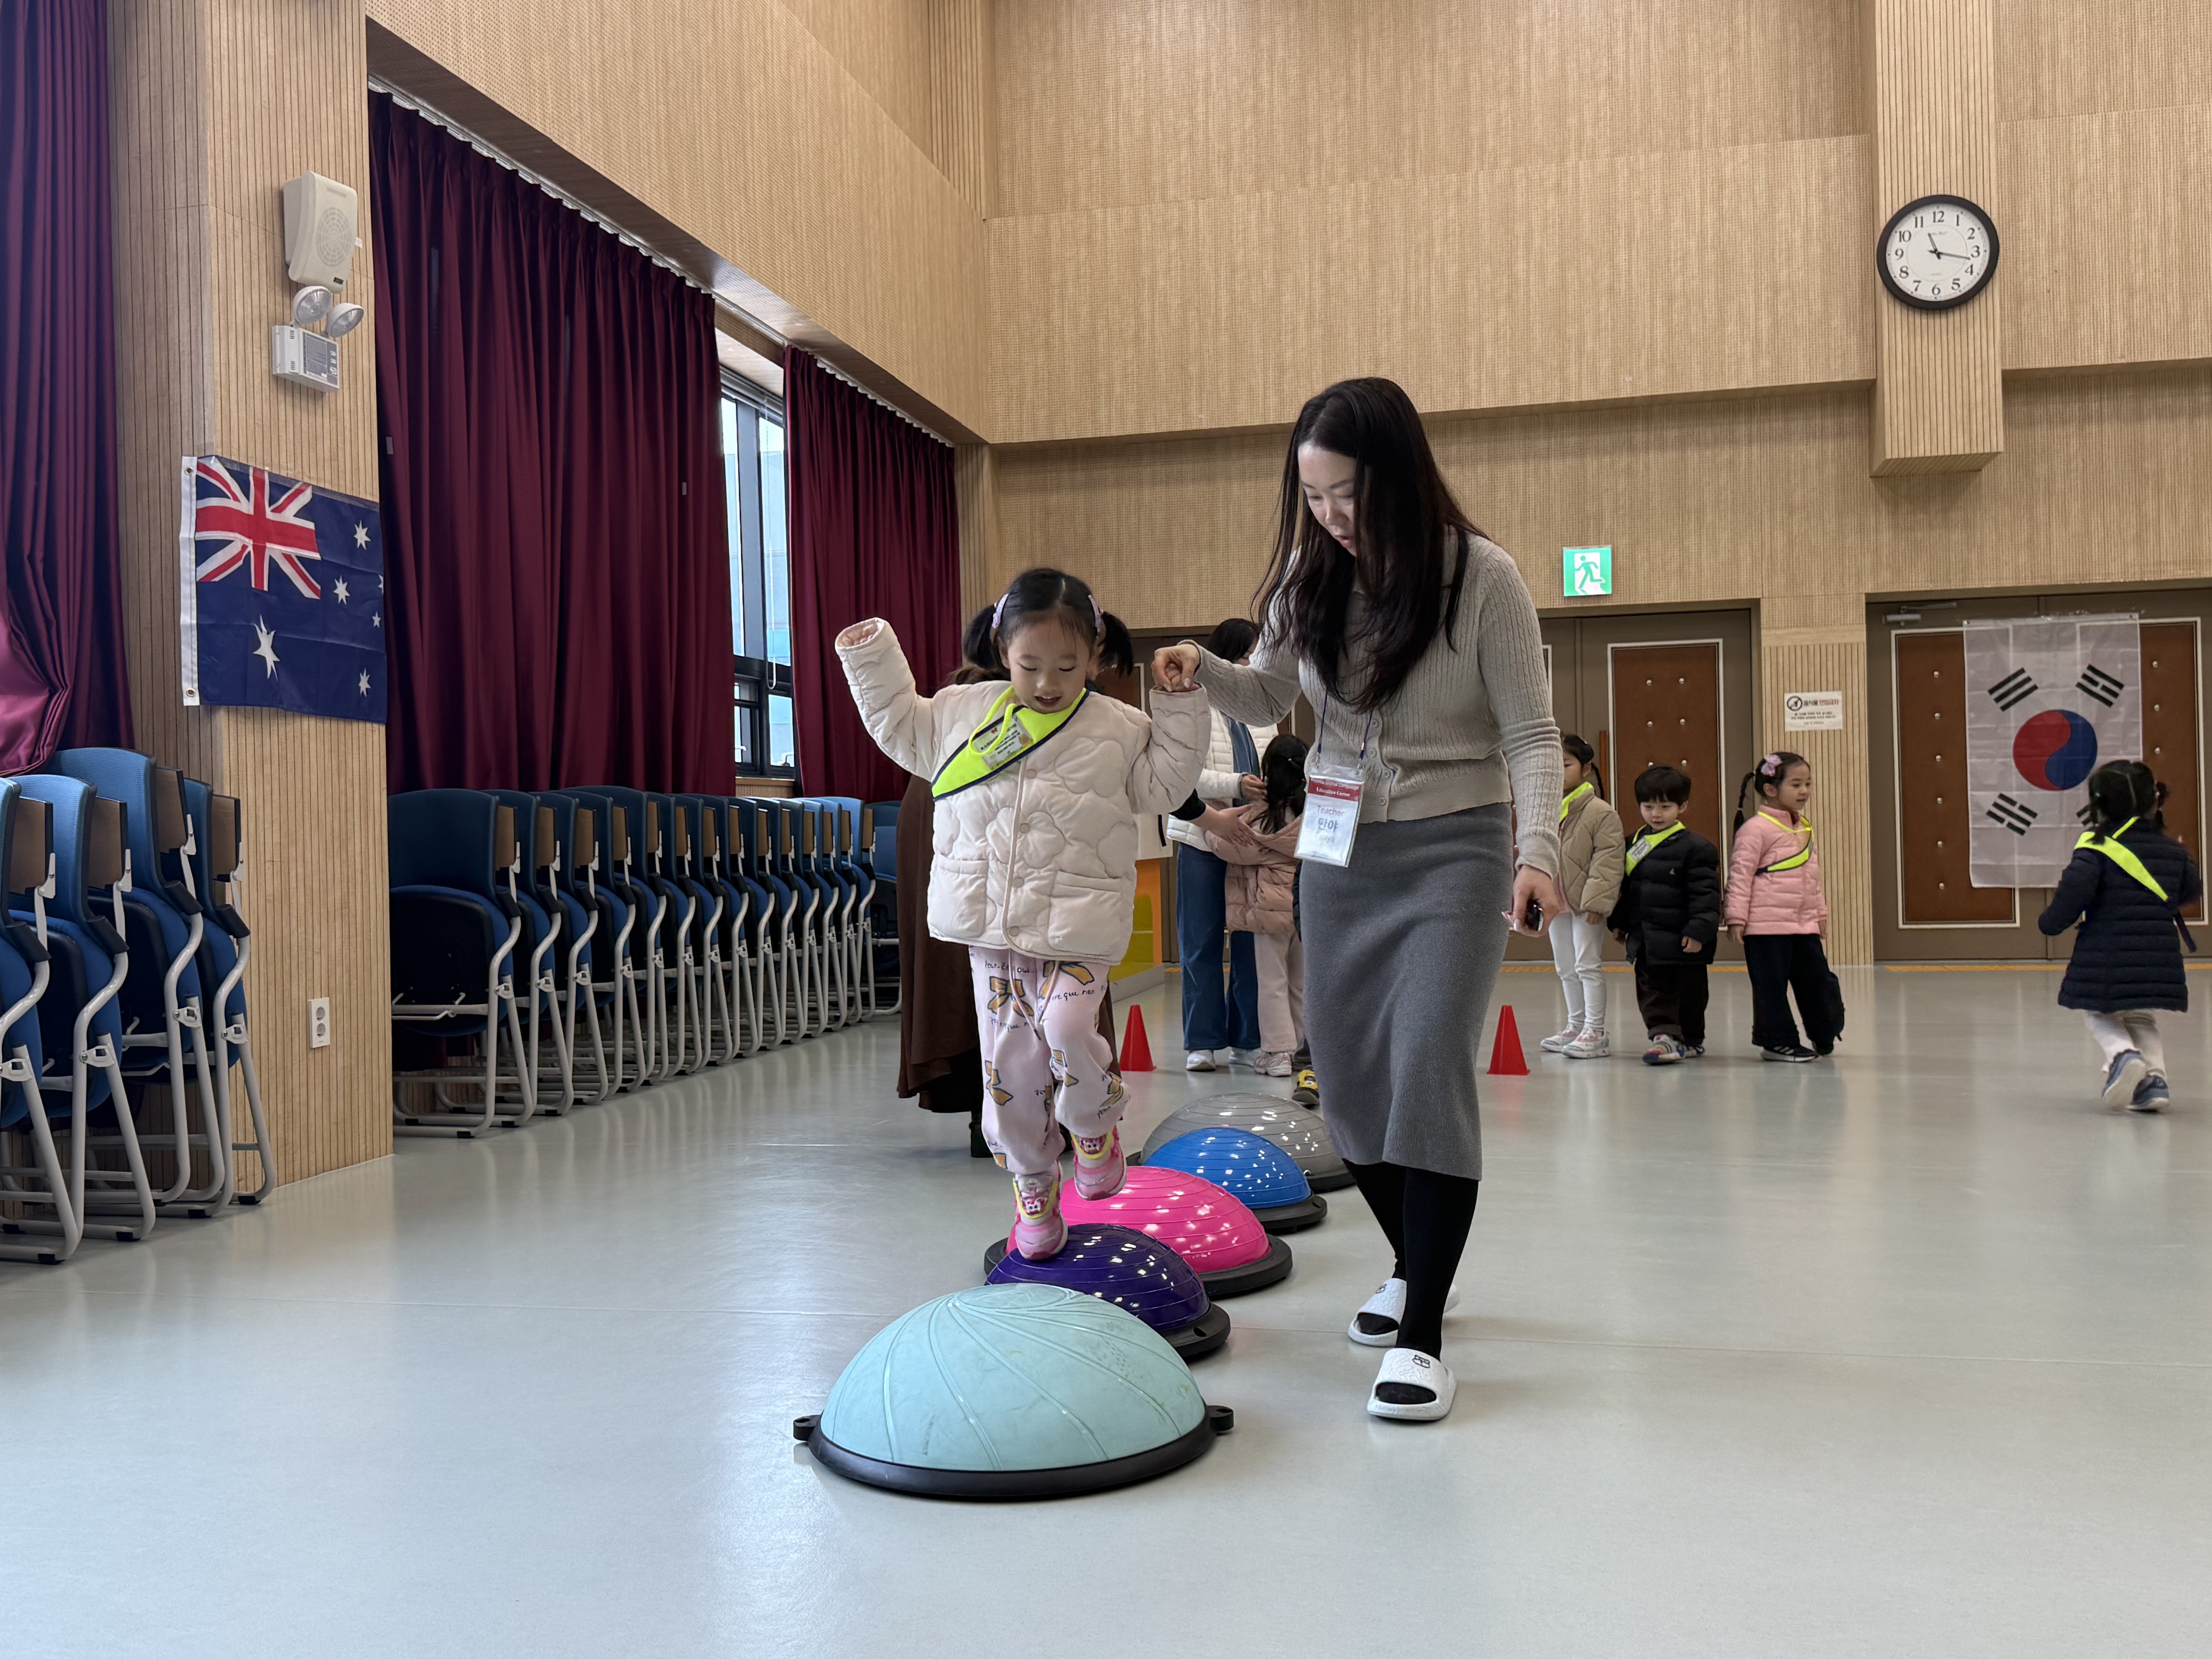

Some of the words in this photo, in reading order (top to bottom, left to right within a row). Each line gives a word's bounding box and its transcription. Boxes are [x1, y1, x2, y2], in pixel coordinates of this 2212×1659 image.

[1914, 216, 1923, 228] 11
[1932, 211, 1944, 223] 12
[1956, 214, 1960, 226] 1
[1898, 230, 1911, 242] 10
[1967, 227, 1975, 240] 2
[1895, 248, 1904, 260] 9
[1970, 245, 1980, 258] 3
[1899, 266, 1909, 278] 8
[1965, 264, 1973, 276] 4
[1913, 280, 1922, 292] 7
[1932, 283, 1941, 295] 6
[1951, 278, 1960, 290] 5
[1317, 805, 1345, 816] Teacher
[1318, 818, 1338, 833] 탄야
